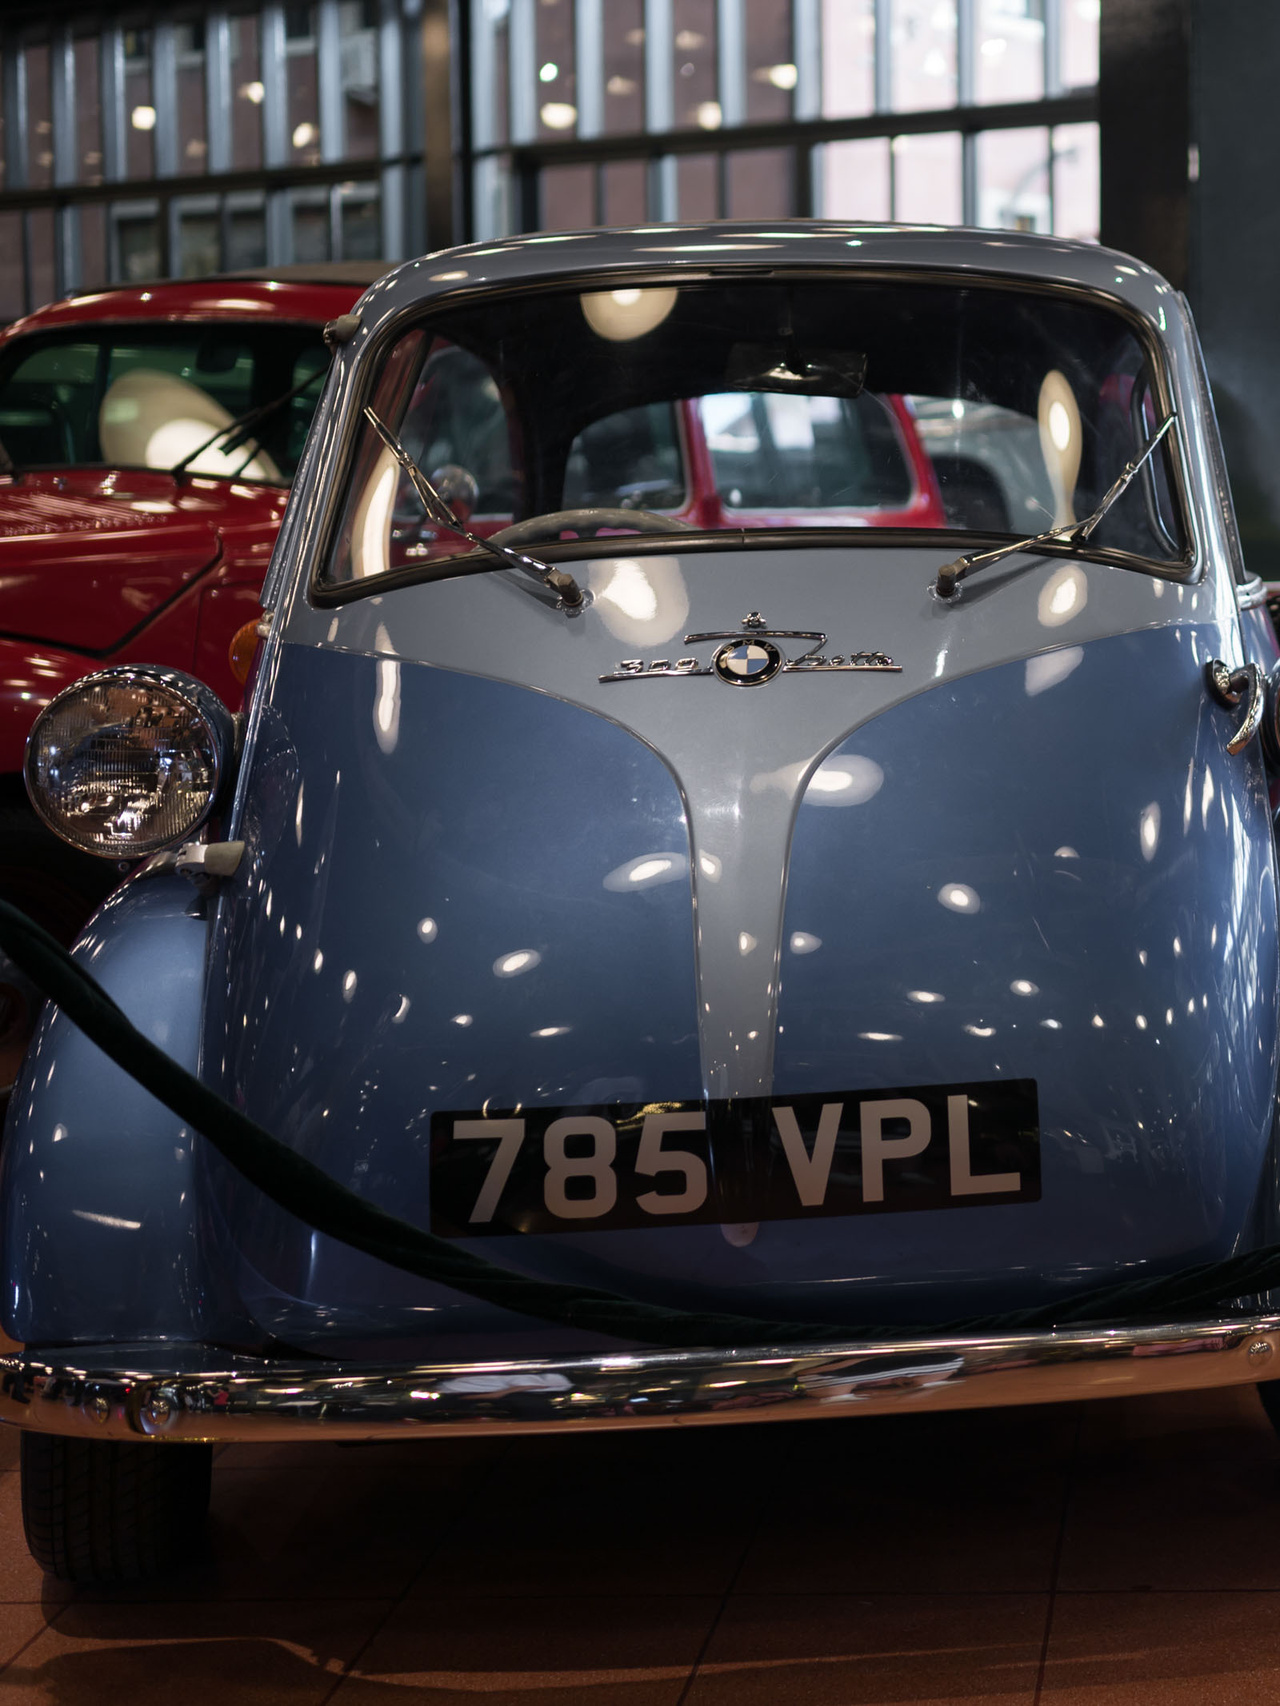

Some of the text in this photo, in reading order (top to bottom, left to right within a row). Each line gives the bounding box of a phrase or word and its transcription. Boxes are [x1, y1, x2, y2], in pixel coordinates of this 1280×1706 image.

[722, 639, 777, 653] BMW
[453, 1095, 1021, 1223] 785 VPL
